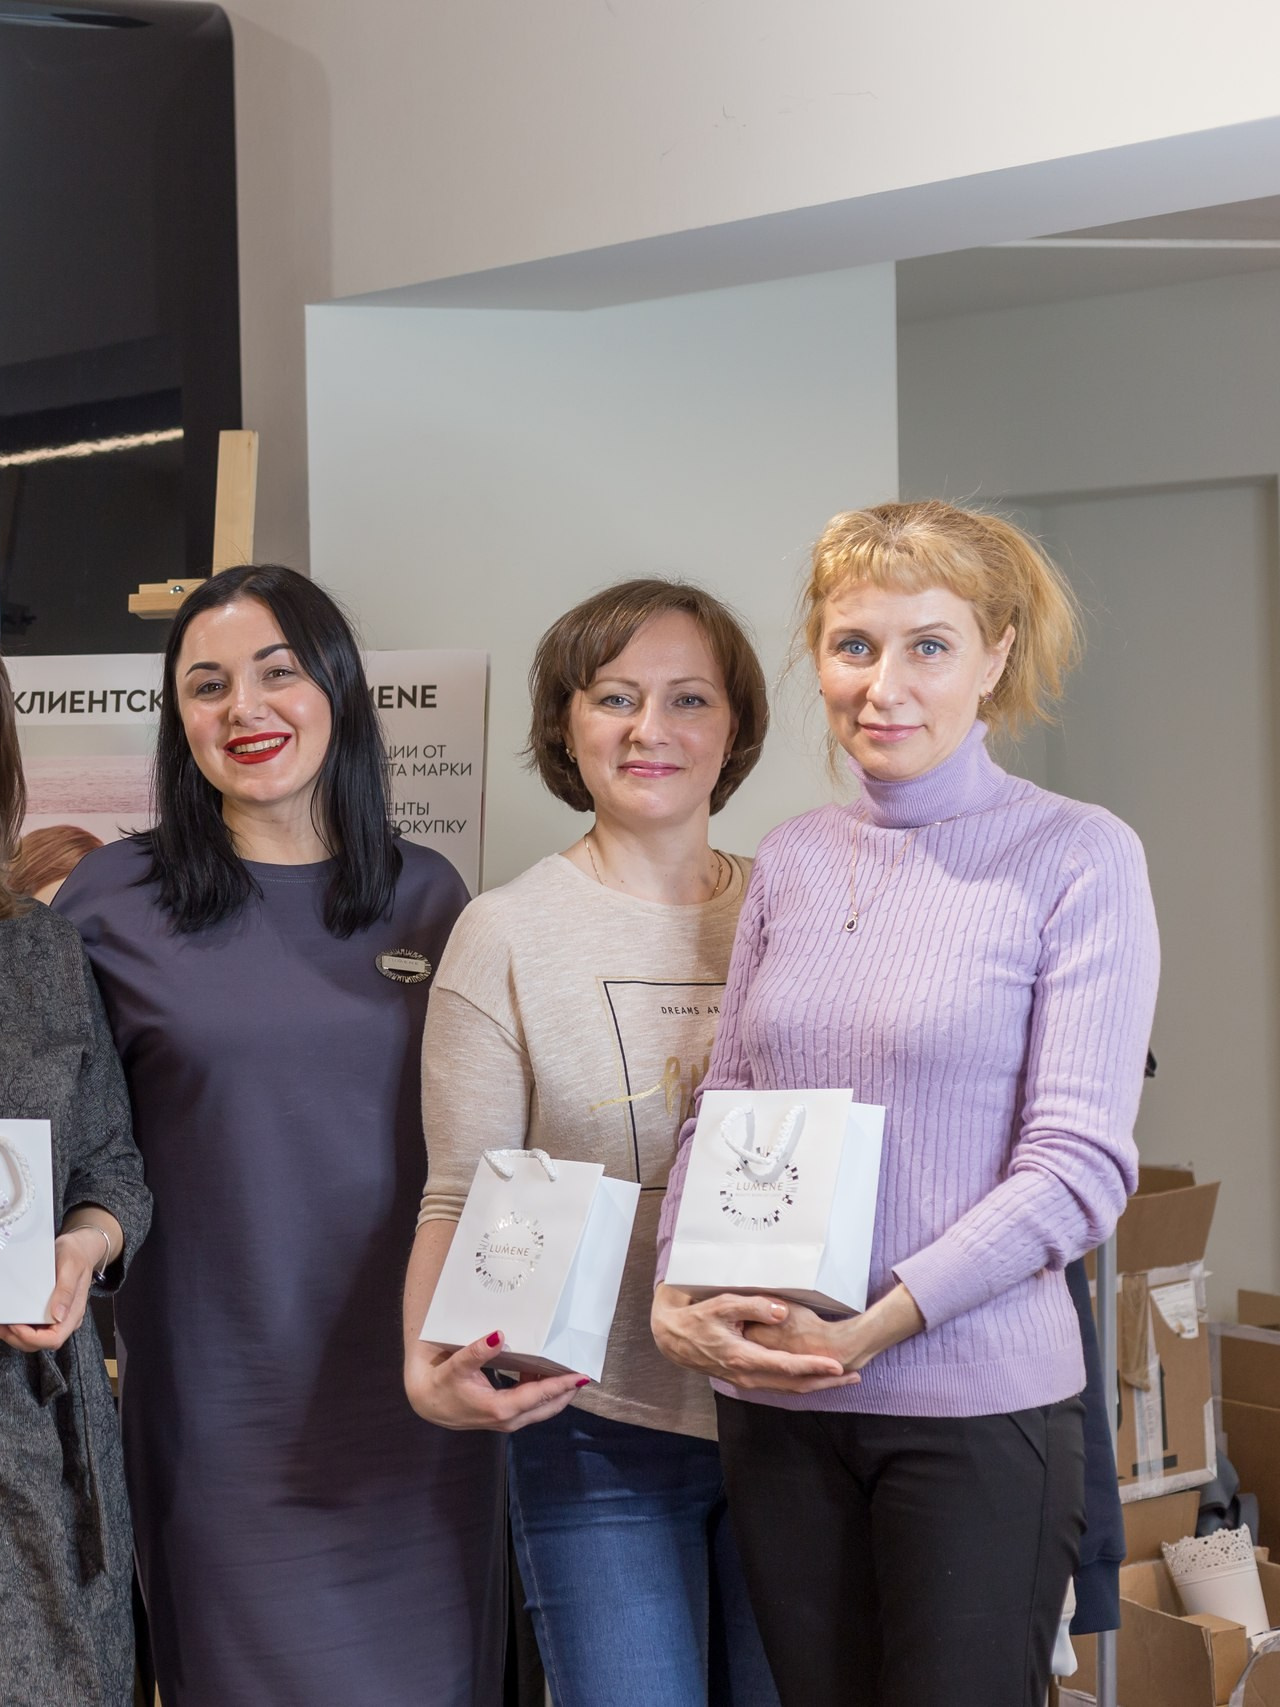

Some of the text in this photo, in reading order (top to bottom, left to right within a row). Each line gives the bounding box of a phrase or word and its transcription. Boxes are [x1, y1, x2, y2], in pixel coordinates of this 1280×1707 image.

[423, 744, 447, 759] ОТ
[412, 762, 472, 777] МАРКИ
[660, 1006, 700, 1015] DREAMS
[736, 1180, 784, 1191] LUMENE
[489, 1243, 530, 1257] LUMENE
